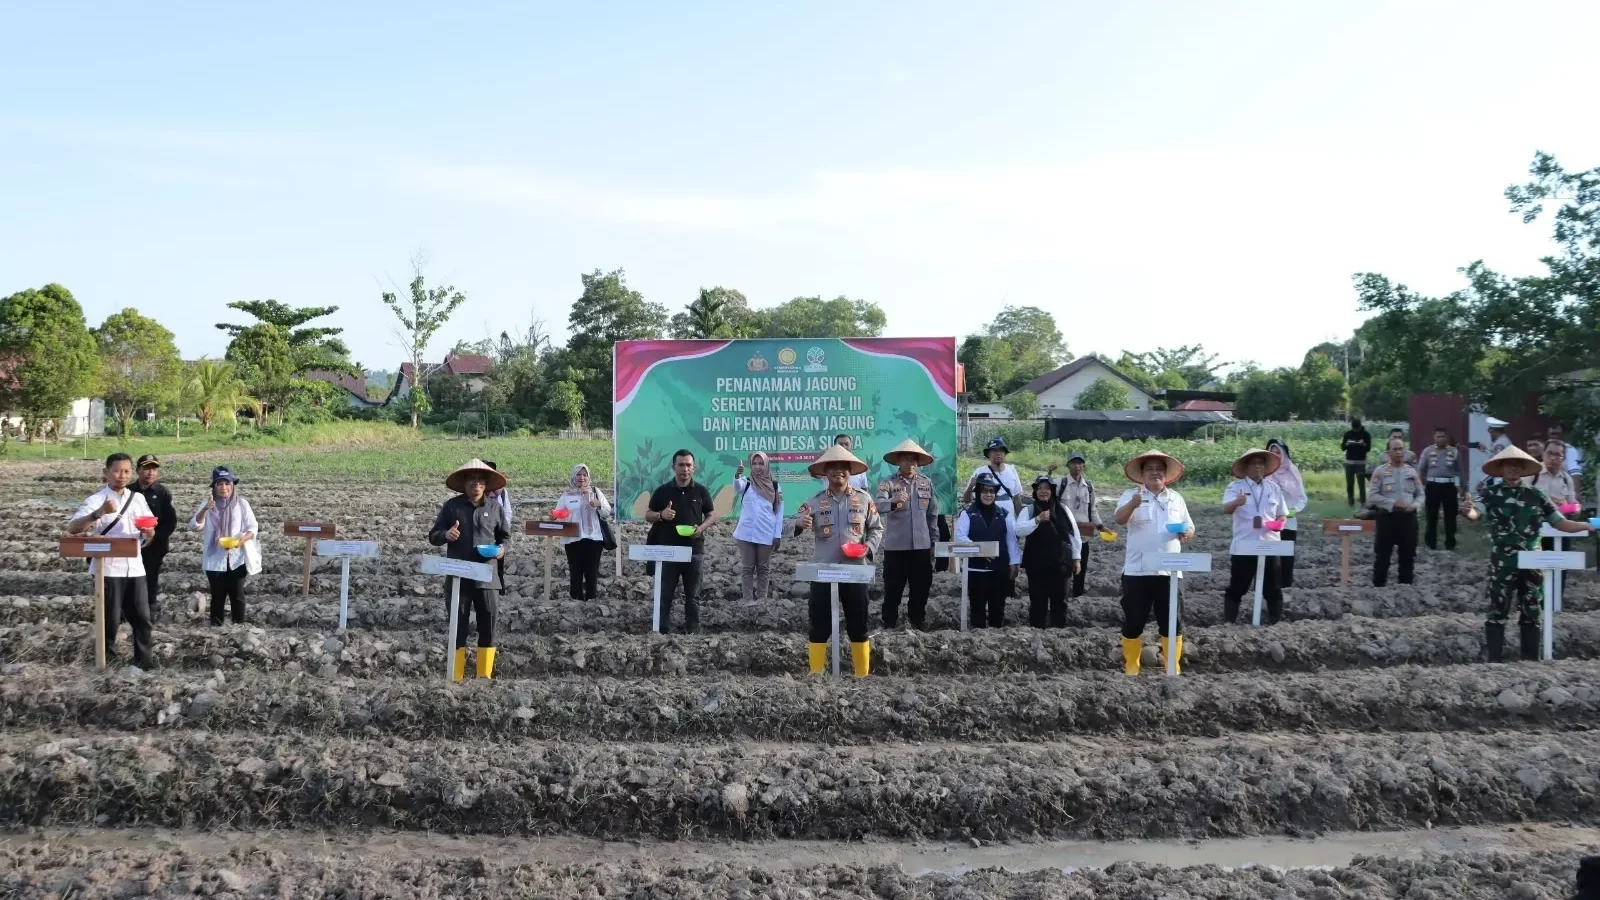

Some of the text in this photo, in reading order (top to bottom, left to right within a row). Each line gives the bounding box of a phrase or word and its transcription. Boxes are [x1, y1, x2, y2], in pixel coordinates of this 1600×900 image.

[716, 376, 857, 393] PENANAMAN JAGUNG
[711, 396, 862, 412] SERENTAK KUARTAL III
[702, 415, 876, 432] DAN PENANAMAN JAGUNG
[715, 435, 863, 451] DI LAHAN DESA SUA
